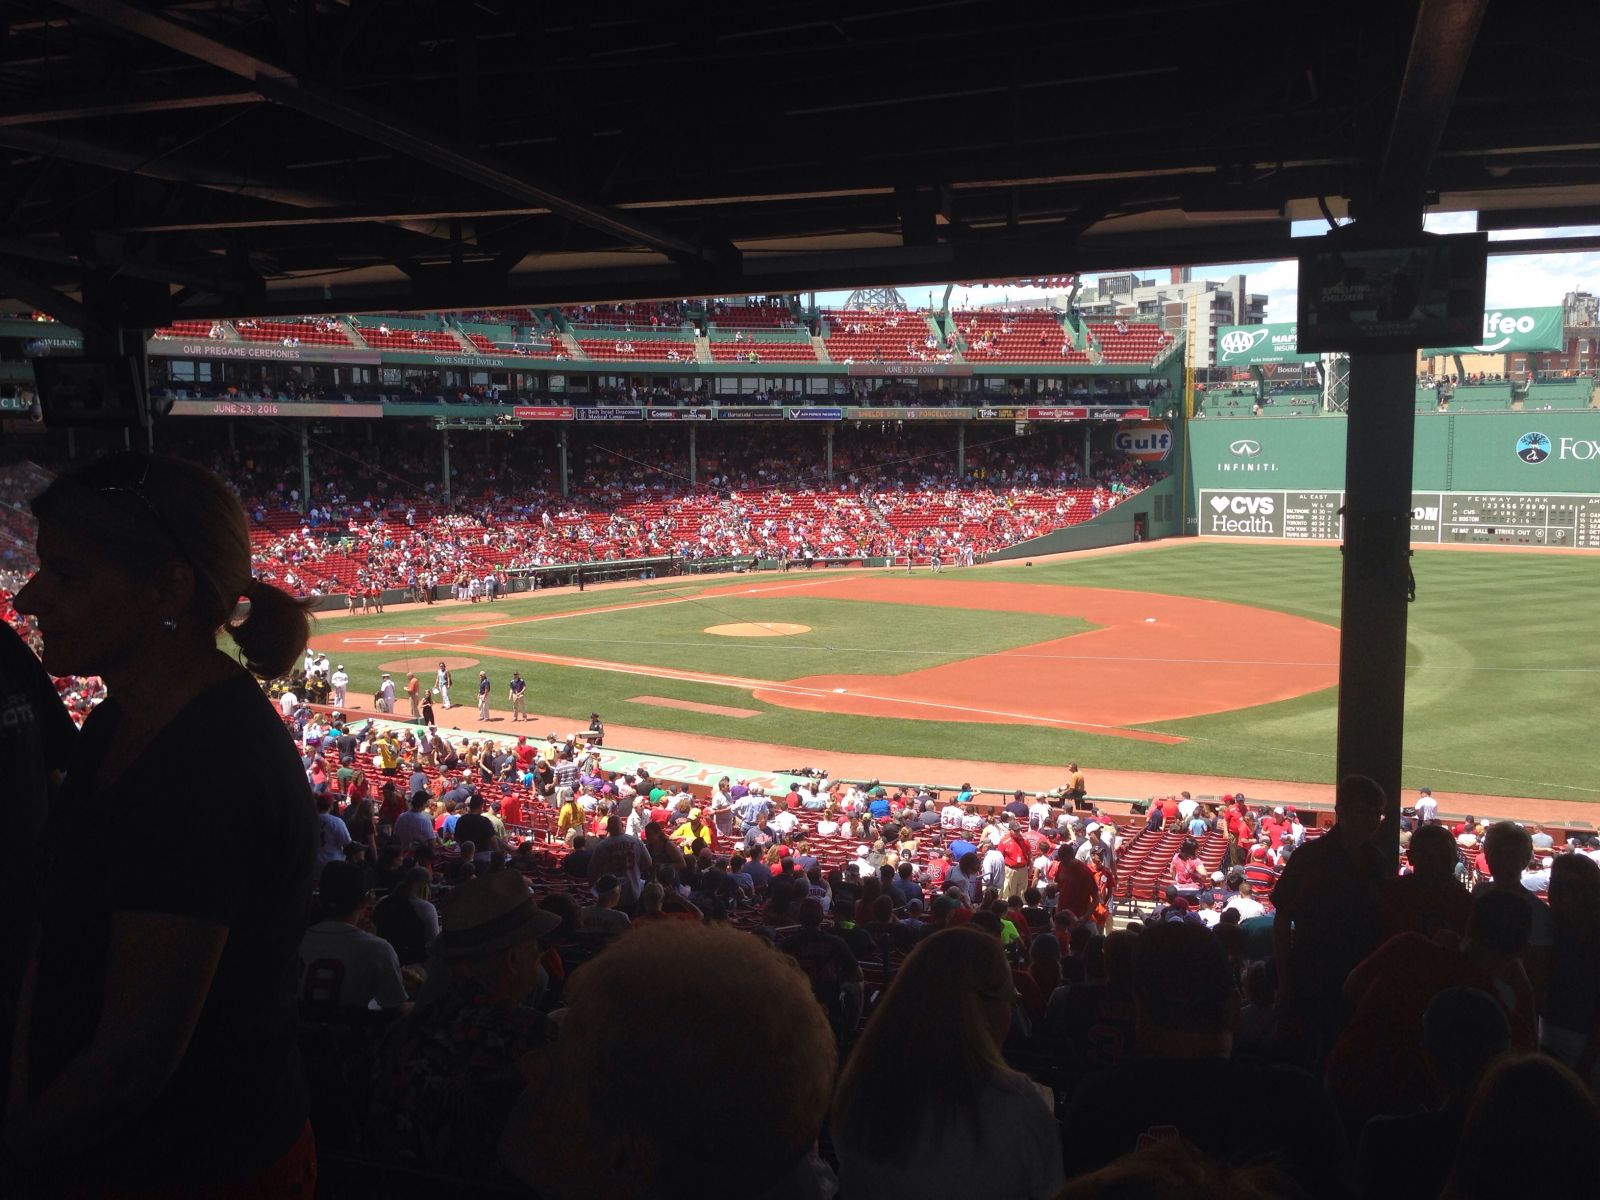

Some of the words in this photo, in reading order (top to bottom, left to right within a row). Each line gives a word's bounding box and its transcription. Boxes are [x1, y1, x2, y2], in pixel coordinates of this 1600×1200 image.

[1224, 333, 1252, 352] AAA
[1271, 334, 1297, 344] MAP
[183, 345, 202, 354] OUR
[204, 346, 246, 356] PREGAME
[248, 348, 300, 358] CEREMONIES
[904, 366, 916, 375] 23,
[918, 366, 934, 374] 2016
[213, 404, 237, 413] JUNE
[240, 405, 254, 415] 23,
[257, 404, 278, 414] 2016
[978, 409, 998, 418] Tribe
[1116, 432, 1169, 450] Gulf
[1230, 496, 1274, 515] CVS
[1211, 514, 1274, 534] Health
[304, 957, 346, 1004] 8
